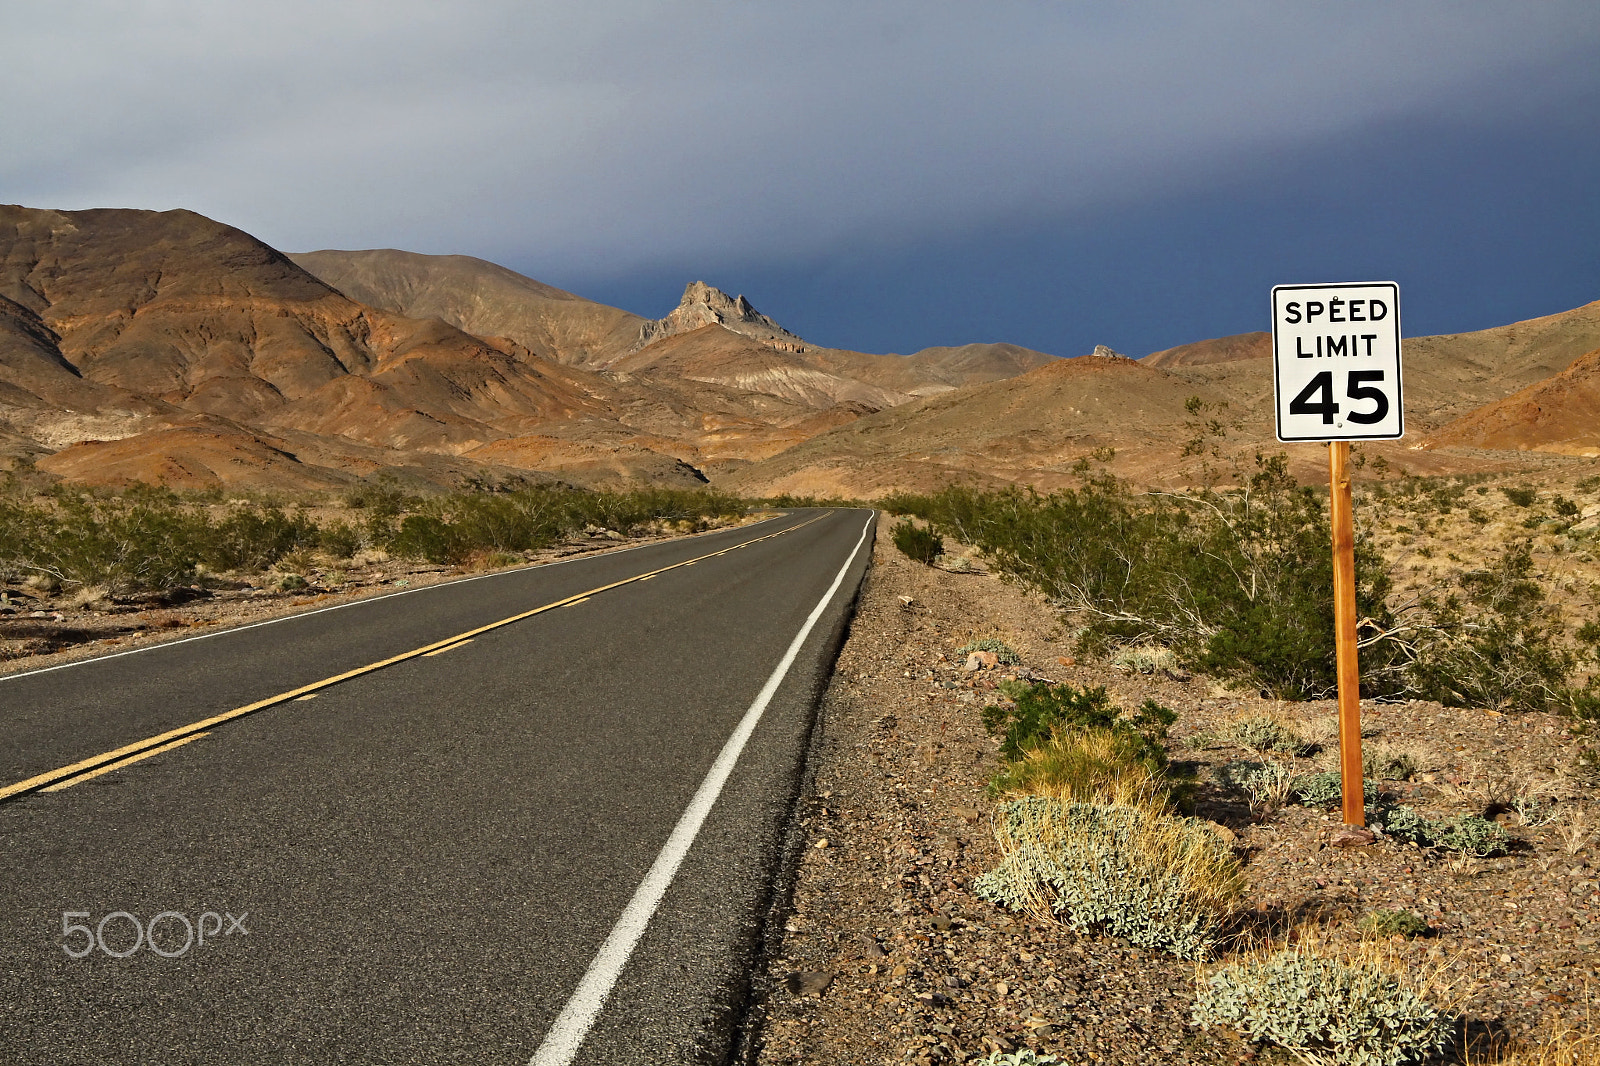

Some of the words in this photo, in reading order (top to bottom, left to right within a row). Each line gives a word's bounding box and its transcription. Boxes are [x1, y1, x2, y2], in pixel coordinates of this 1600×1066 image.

[1285, 300, 1388, 324] SPEED
[1296, 334, 1378, 358] LIMIT
[1289, 370, 1389, 425] 45
